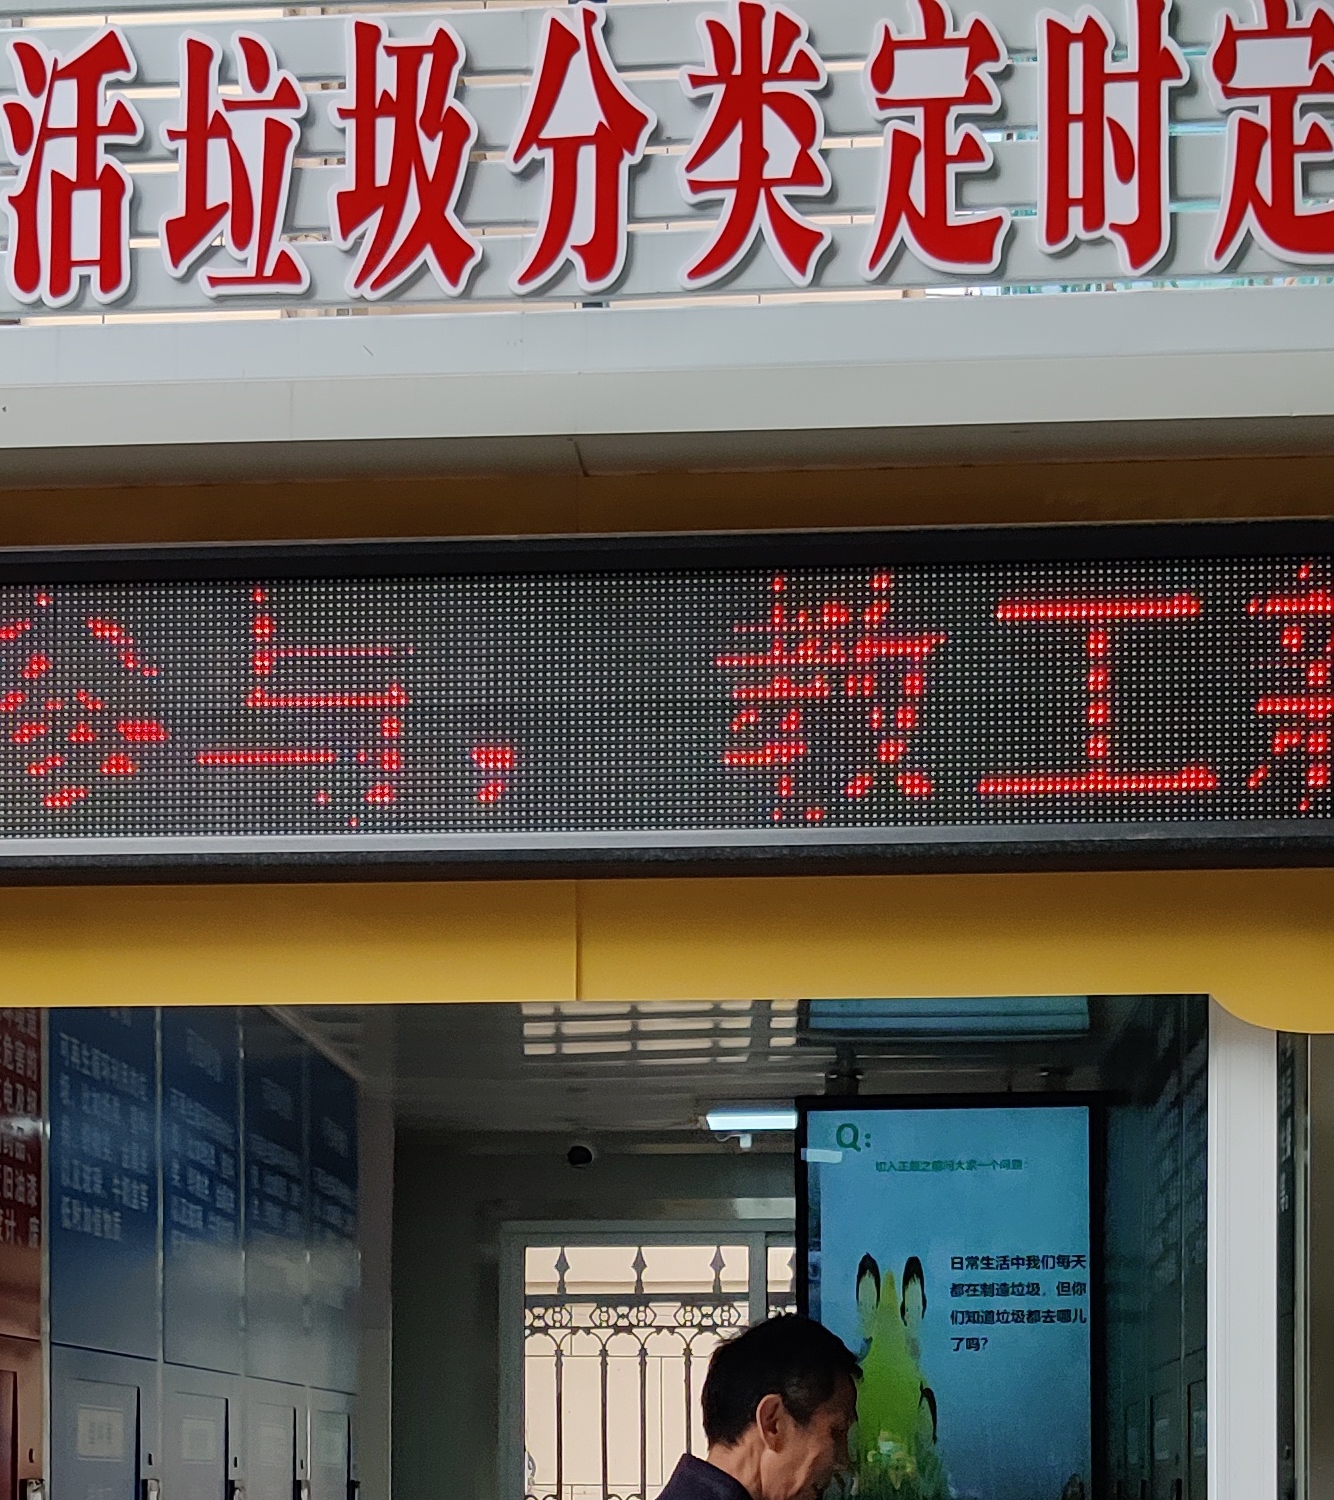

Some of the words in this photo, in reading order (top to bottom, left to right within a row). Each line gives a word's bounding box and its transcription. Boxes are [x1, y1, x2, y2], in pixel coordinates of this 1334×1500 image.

[950, 1255, 1087, 1271] 日常生活中我们每天
[950, 1309, 1087, 1325] 们知道垃圾都去哪儿
